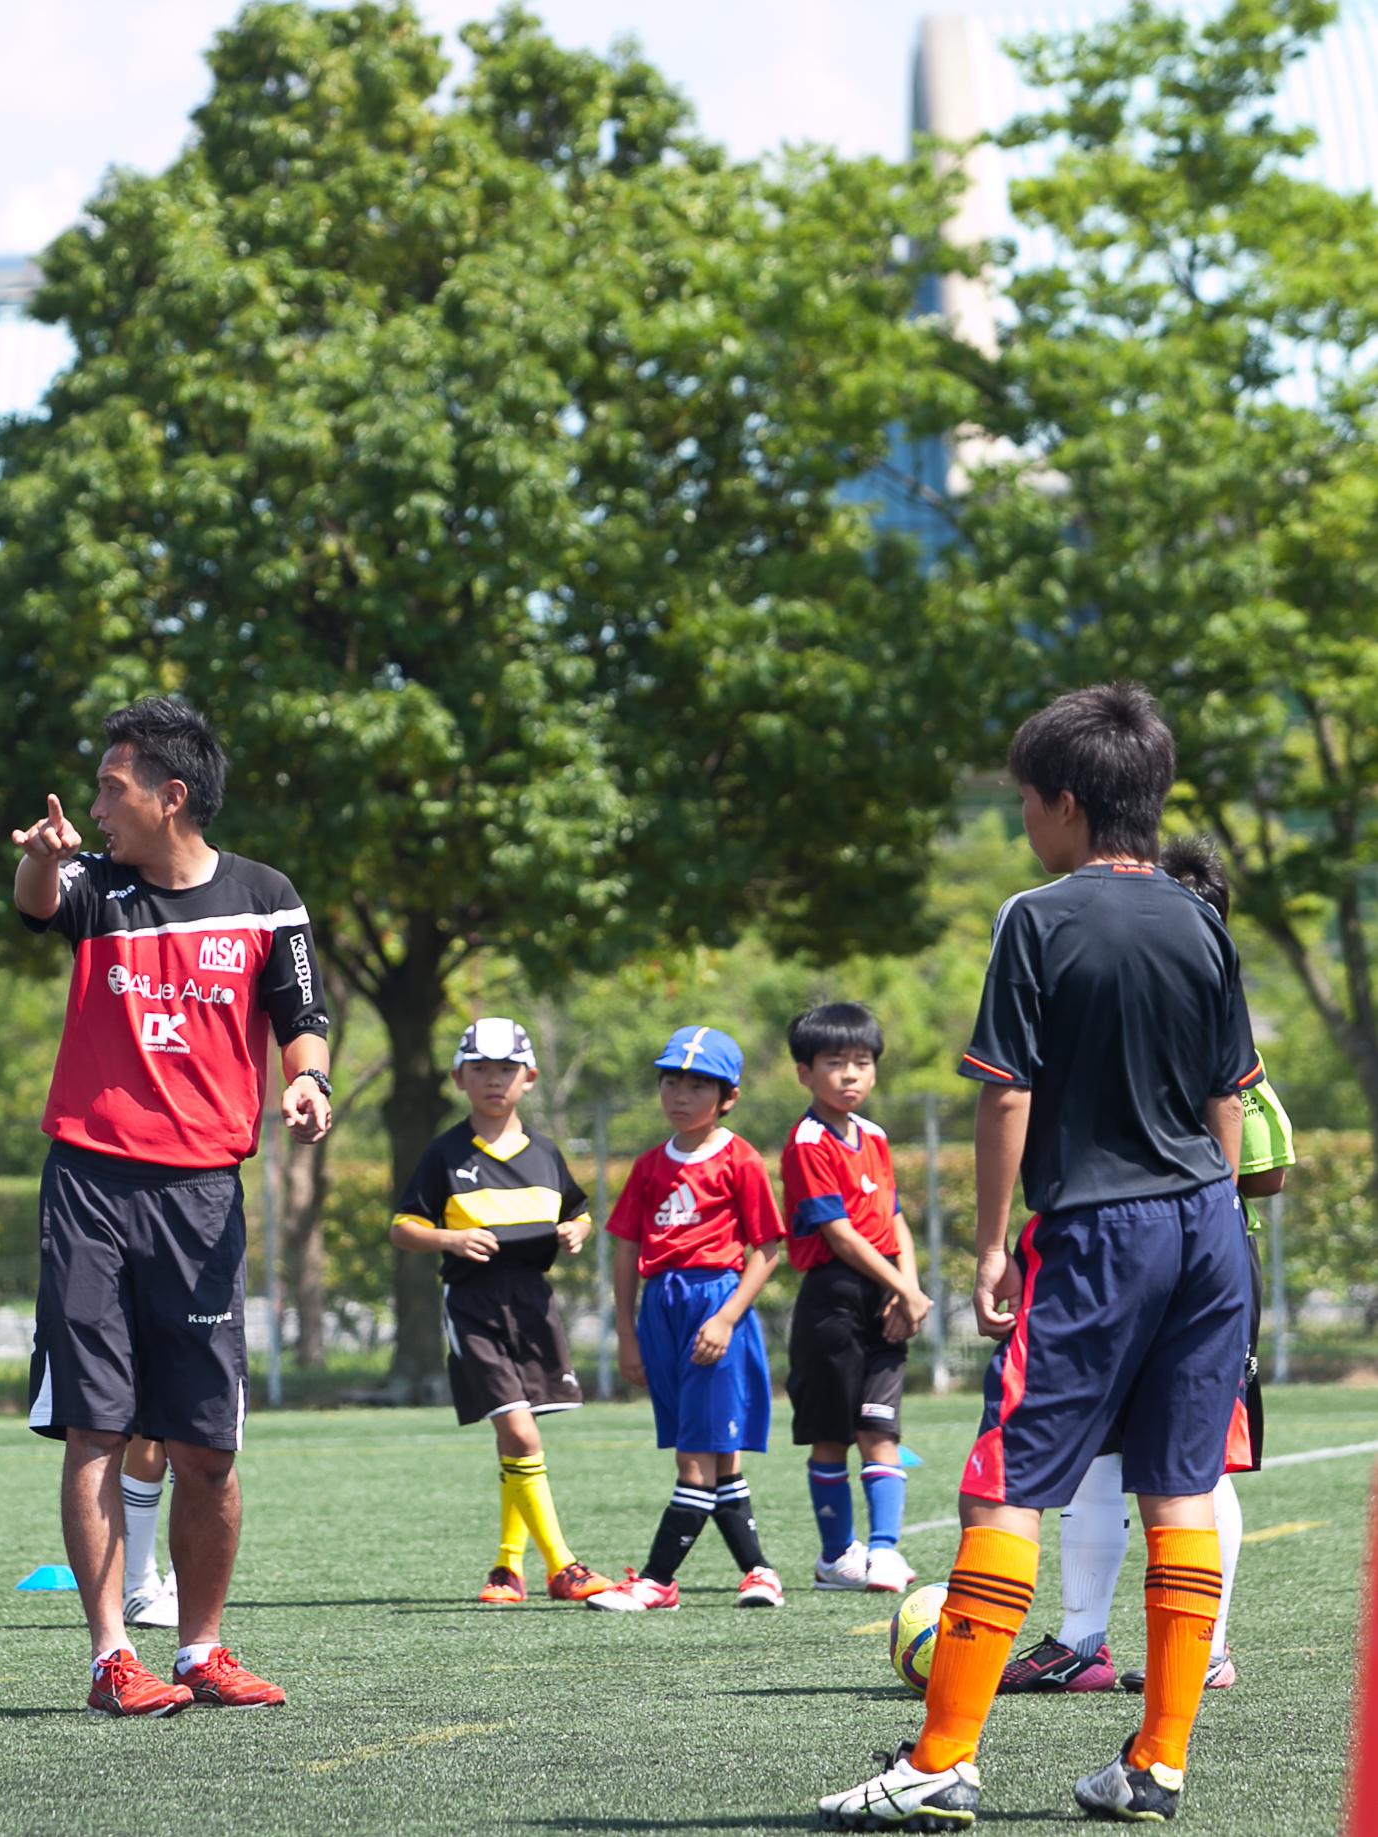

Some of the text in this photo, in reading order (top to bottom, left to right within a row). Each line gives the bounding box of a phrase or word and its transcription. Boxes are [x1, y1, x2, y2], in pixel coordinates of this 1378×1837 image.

[199, 935, 246, 969] MSA
[289, 932, 314, 1006] Kappa
[128, 974, 236, 1005] Aiue Auto
[188, 1312, 232, 1324] Kappa
